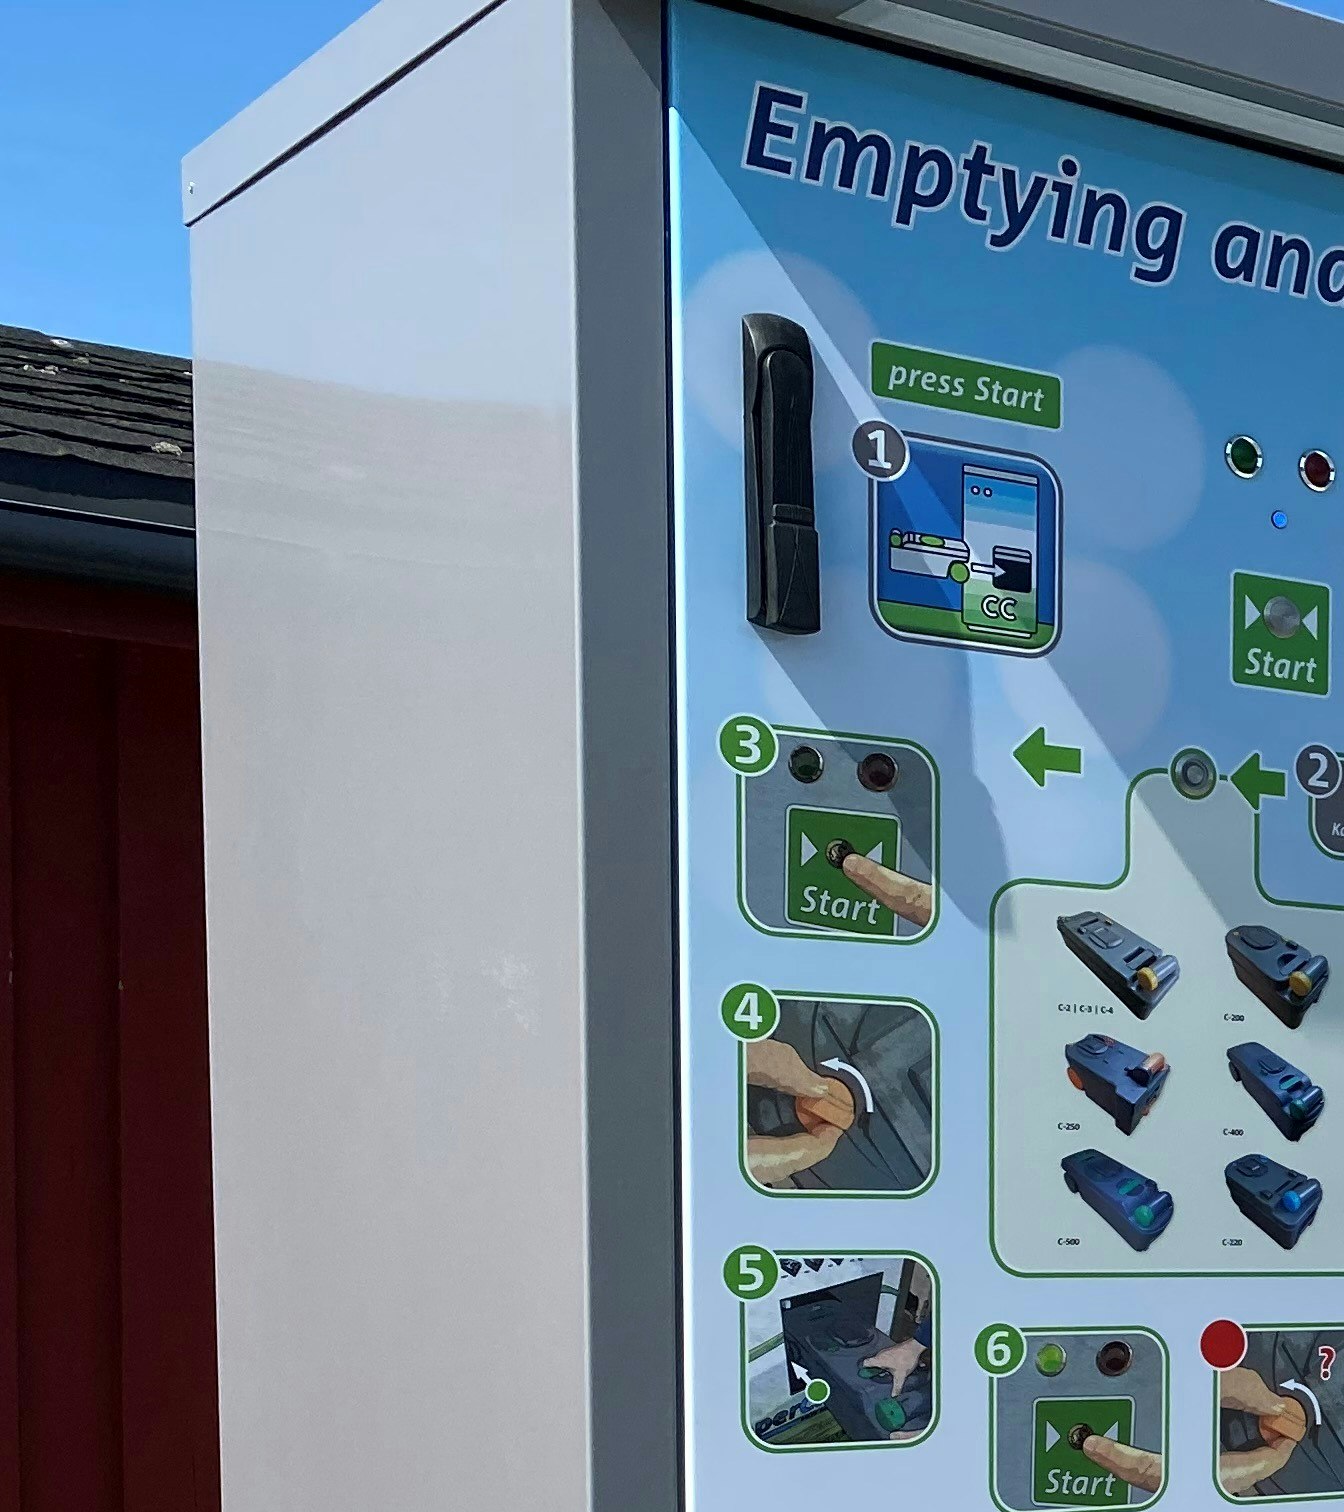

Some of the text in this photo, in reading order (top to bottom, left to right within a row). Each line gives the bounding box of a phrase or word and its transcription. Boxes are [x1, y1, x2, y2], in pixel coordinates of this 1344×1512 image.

[743, 84, 1184, 283] Emptying
[889, 363, 1045, 412] press Start
[867, 431, 891, 468] 1
[982, 596, 1017, 620] CC
[1245, 648, 1317, 683] Start
[735, 724, 761, 764] 3
[1308, 753, 1329, 788] 2
[800, 886, 880, 925] Start
[734, 992, 762, 1031] 4
[738, 1253, 764, 1292] 5
[987, 1331, 1011, 1366] 6
[1045, 1468, 1116, 1497] Start
